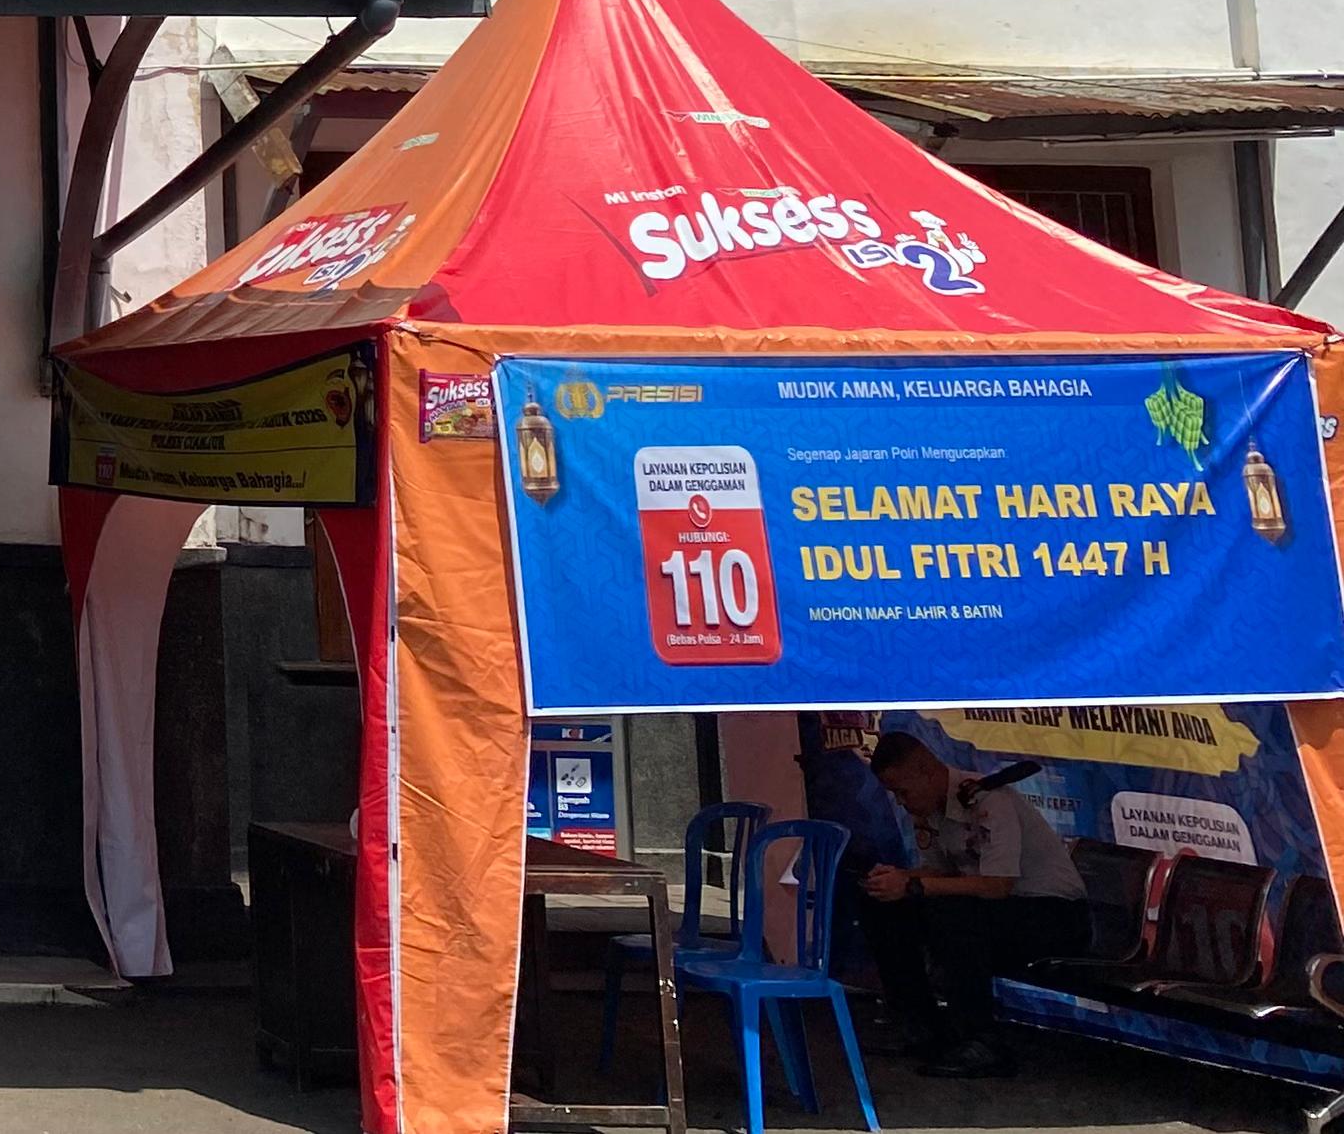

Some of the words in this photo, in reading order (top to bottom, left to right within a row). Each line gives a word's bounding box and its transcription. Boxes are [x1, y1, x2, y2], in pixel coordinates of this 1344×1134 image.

[604, 191, 628, 205] Mi
[633, 184, 687, 201] Instan
[607, 385, 703, 403] PRESISI
[778, 381, 838, 399] MUDIK
[841, 380, 900, 401] AMAN,
[903, 379, 1006, 398] KELUARGA
[1008, 378, 1093, 397] BAHAGIA
[787, 447, 842, 463] Segenap
[845, 447, 889, 463] Jajaran
[643, 463, 688, 476] LAYANAN
[690, 462, 747, 475] KEPOLISIAN
[649, 480, 683, 492] DALAM
[685, 479, 746, 491] GENGGAMAN
[791, 485, 983, 521] SELAMAT
[995, 483, 1098, 519] HARI
[1109, 480, 1217, 517] RAYA
[678, 532, 731, 544] HUBUNGI:
[799, 545, 902, 582] IDUL
[910, 542, 1022, 579] FITRI
[1031, 540, 1129, 577] 1447
[1142, 540, 1171, 575] H
[661, 548, 759, 628] 110
[809, 606, 863, 622] MOHON
[865, 606, 903, 621] MAAF
[906, 605, 948, 620] LAHIR
[950, 605, 960, 620] &
[963, 604, 1003, 620] BATIN
[1068, 706, 1169, 738] MELAYANI
[1170, 711, 1218, 747] ANDA
[823, 728, 861, 750] JAGA
[1121, 806, 1175, 826] LAYANAN
[1177, 814, 1241, 836] KEPOLISIAN
[1129, 825, 1170, 842] DALAM
[1171, 830, 1241, 853] GENGGAMAN
